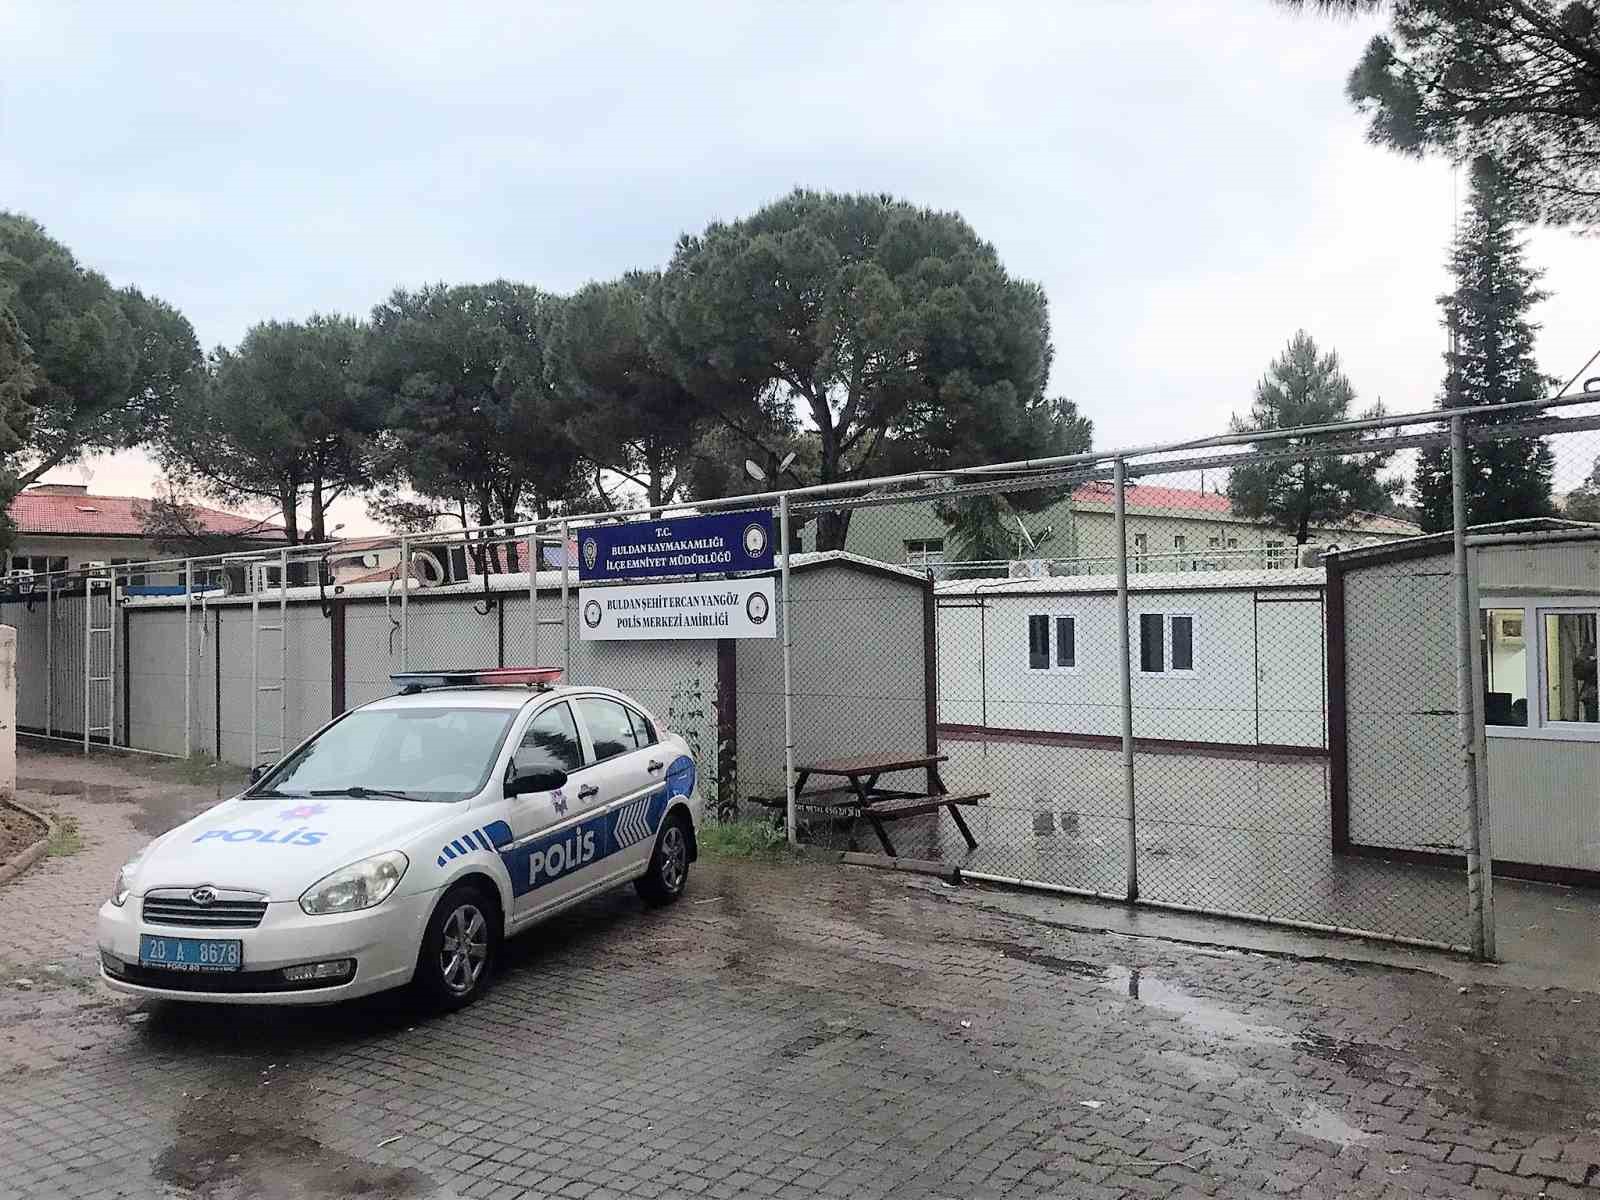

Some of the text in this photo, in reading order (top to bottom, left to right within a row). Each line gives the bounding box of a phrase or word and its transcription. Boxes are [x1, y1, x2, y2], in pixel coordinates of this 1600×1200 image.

[611, 537, 723, 556] BULDAN KAYMAKAMLIĞI
[606, 551, 731, 571] İLÇE EMNİYET MÜDÜRLÜĞÜ
[607, 592, 739, 610] BULDAN ŞEHİT ERCAN YANGÖZ
[617, 611, 729, 628] POLİS MERKEZİ AMİRLİĞİ
[528, 827, 595, 885] POLİS
[150, 939, 237, 964] 20 A 8678
